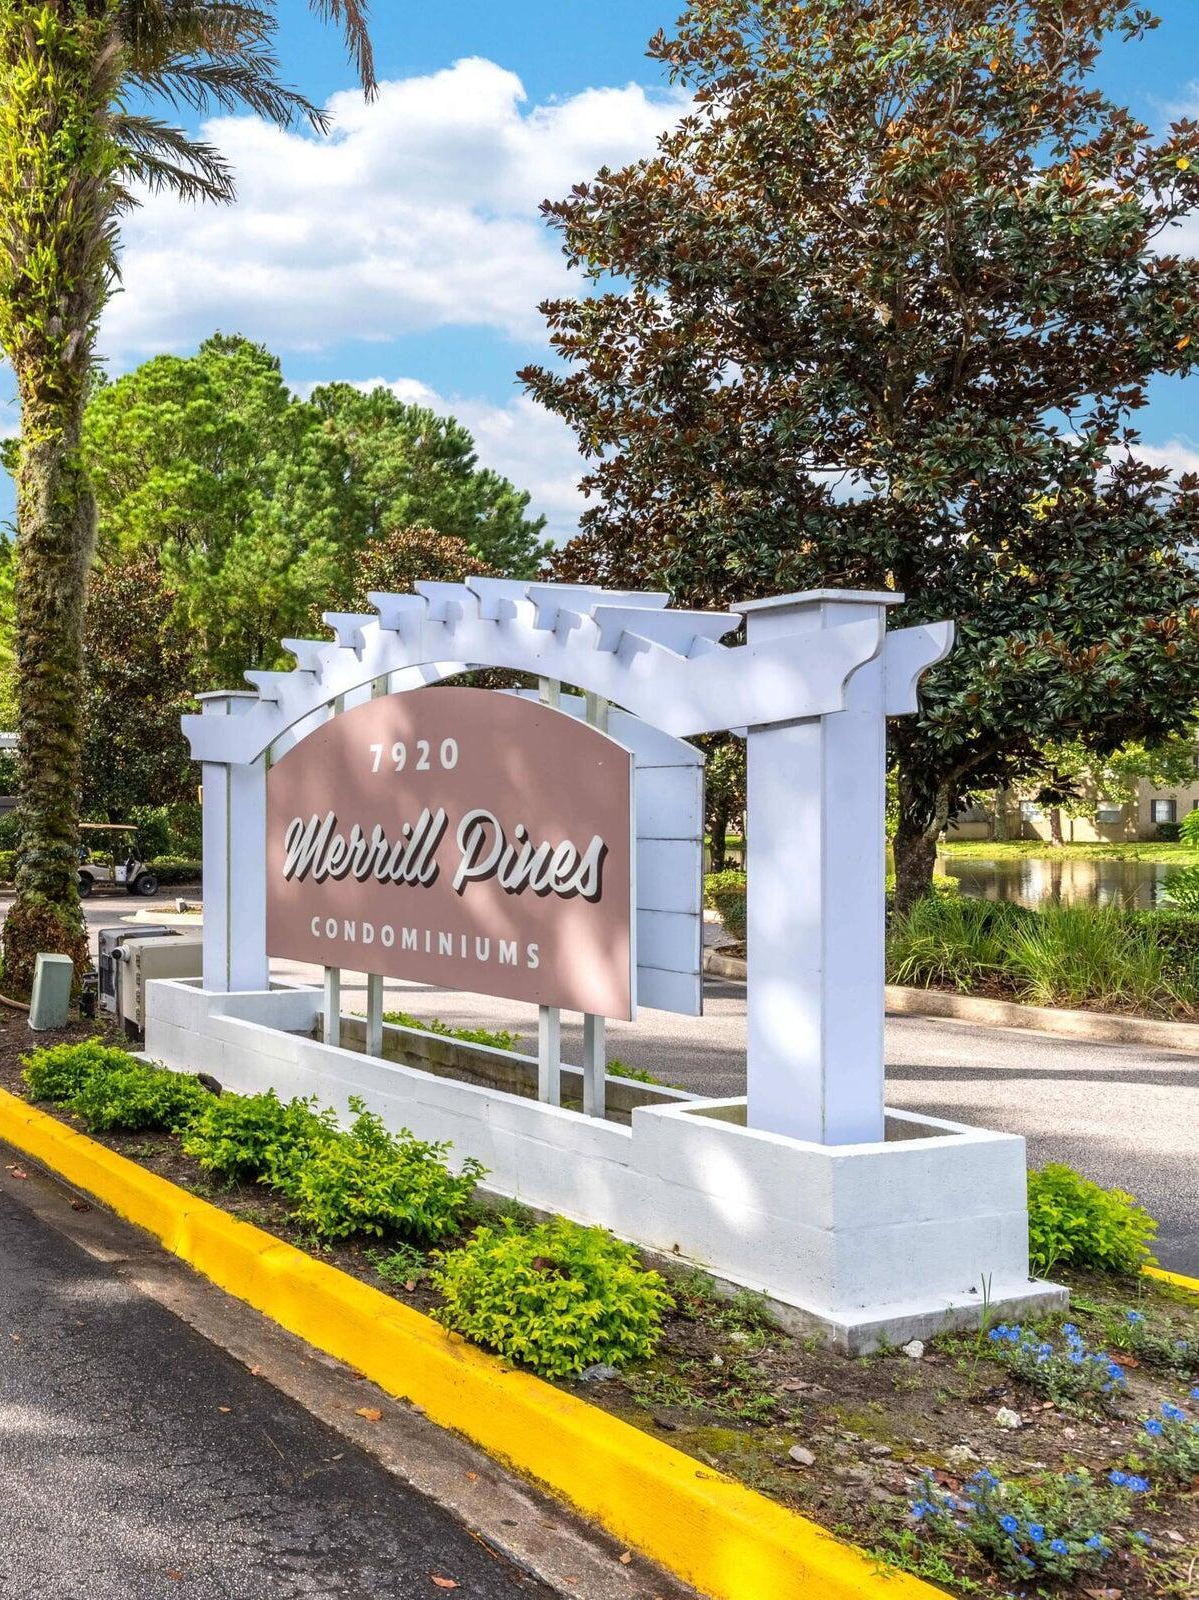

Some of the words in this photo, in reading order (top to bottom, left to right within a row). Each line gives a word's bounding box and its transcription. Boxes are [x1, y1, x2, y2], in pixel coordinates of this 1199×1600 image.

[369, 737, 459, 773] 7920
[282, 807, 449, 888] Merrill
[452, 808, 609, 904] Pines
[310, 916, 540, 969] CONDOMINIUMS
